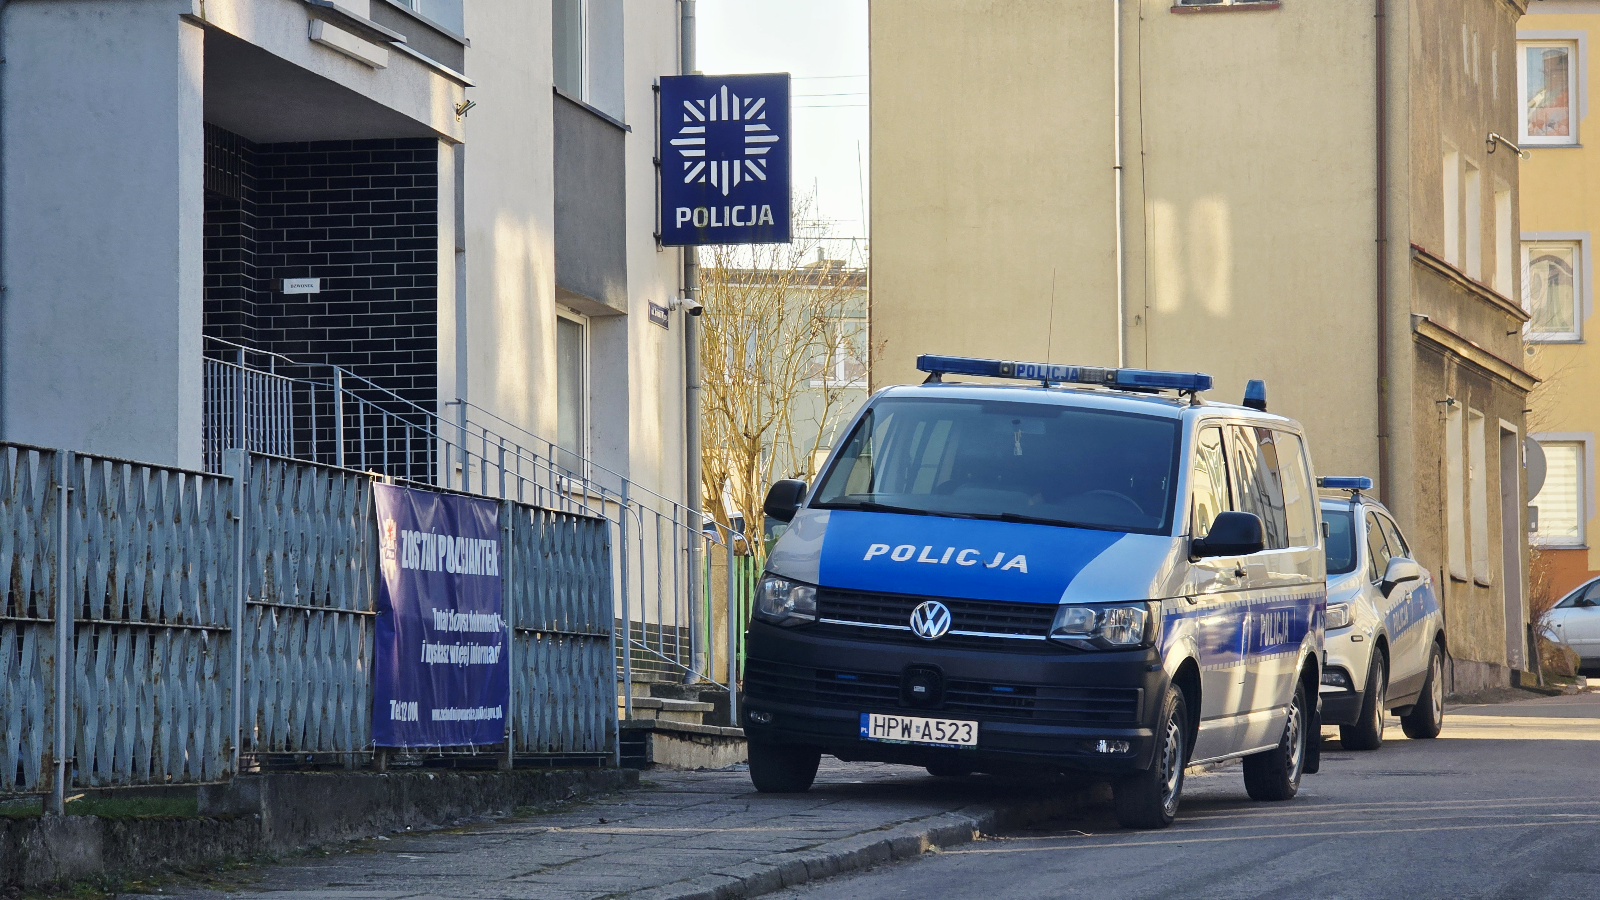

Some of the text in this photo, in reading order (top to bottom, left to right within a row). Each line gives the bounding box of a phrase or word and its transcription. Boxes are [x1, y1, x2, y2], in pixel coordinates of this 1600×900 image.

[676, 205, 774, 228] POLICJA
[1016, 364, 1080, 380] POLICJA
[401, 526, 499, 577] ZOSTAŃ POLCJANTEM
[863, 543, 1029, 574] POLICJA
[432, 607, 449, 633] Tutaj
[469, 610, 502, 633] dokument
[1259, 611, 1289, 647] POLICJA
[450, 641, 470, 667] więej
[470, 642, 502, 665] informaci
[873, 716, 973, 743] HPW A523
